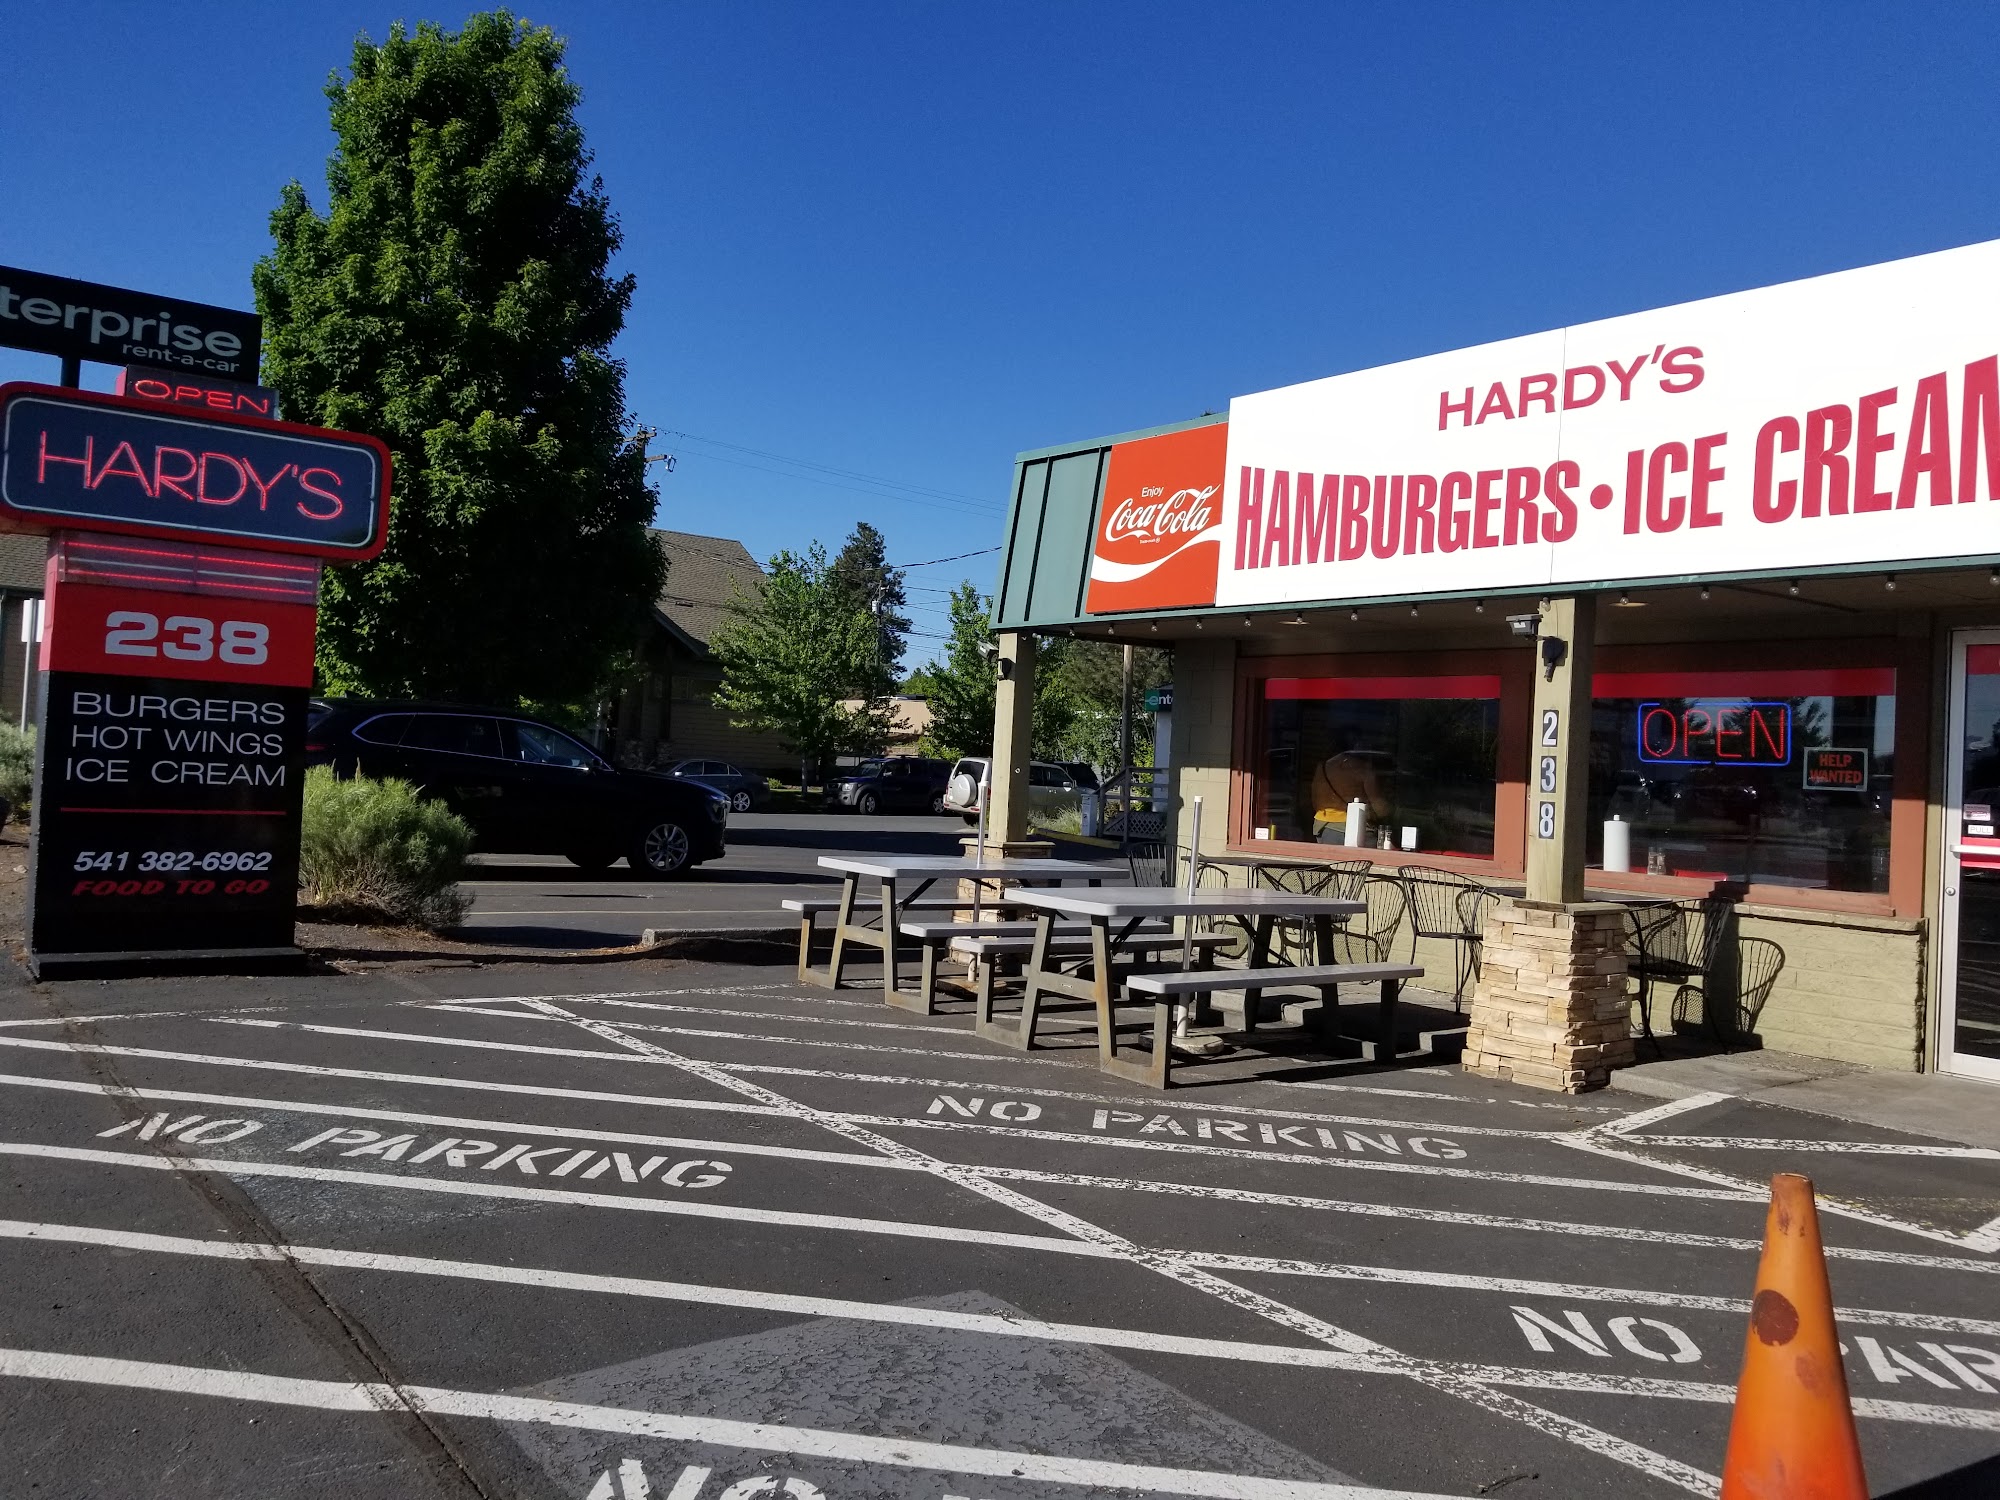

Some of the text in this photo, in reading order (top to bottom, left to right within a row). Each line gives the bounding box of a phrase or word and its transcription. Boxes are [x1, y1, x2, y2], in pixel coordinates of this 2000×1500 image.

[0, 285, 243, 357] terprise
[122, 342, 240, 373] rent-a-car
[134, 379, 268, 413] OPEN
[1438, 345, 1705, 431] HARDY'S
[37, 430, 343, 521] HARDY'S
[1141, 486, 1164, 498] Enjoy
[1105, 484, 1221, 542] Coca-Cola
[1233, 459, 1580, 571] HAMBURGERS
[1624, 431, 1728, 535] ICE
[105, 610, 270, 666] 238
[72, 692, 285, 725] BURGERS
[1148, 694, 1173, 705] ent
[71, 725, 283, 757] HOT WINGS
[1643, 708, 1785, 759] OPEN
[65, 757, 286, 787] ICE CREAM
[1809, 769, 1863, 784] WANTED
[1819, 753, 1852, 767] HELP
[1970, 826, 1991, 834] PULL
[73, 851, 272, 872] 541 382-6962
[72, 879, 271, 896] FOOD TO GO
[926, 1096, 1467, 1160] NO PARKING
[98, 1112, 733, 1189] NO PARKING
[1509, 1305, 2000, 1393] NO AR
